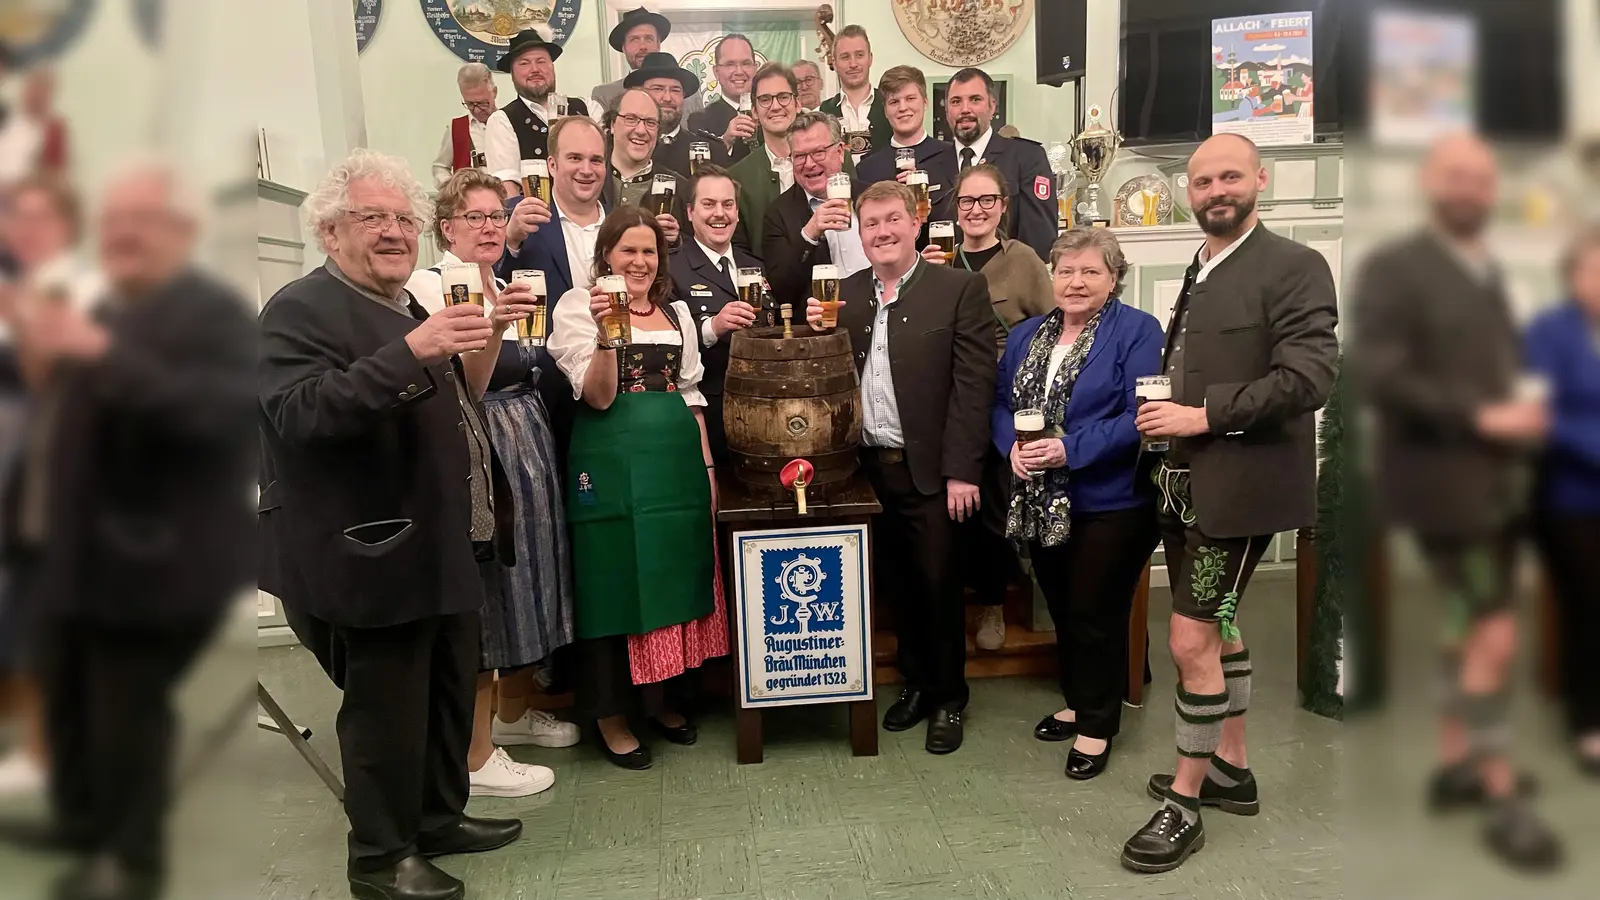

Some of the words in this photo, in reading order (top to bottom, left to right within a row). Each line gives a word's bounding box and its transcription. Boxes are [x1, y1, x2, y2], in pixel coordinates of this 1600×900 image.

[1215, 20, 1260, 34] ALLACH
[1271, 16, 1310, 28] FEIERT
[764, 654, 793, 673] Bräu
[792, 653, 847, 671] München
[765, 673, 822, 691] gegründet
[823, 671, 847, 685] 1328
